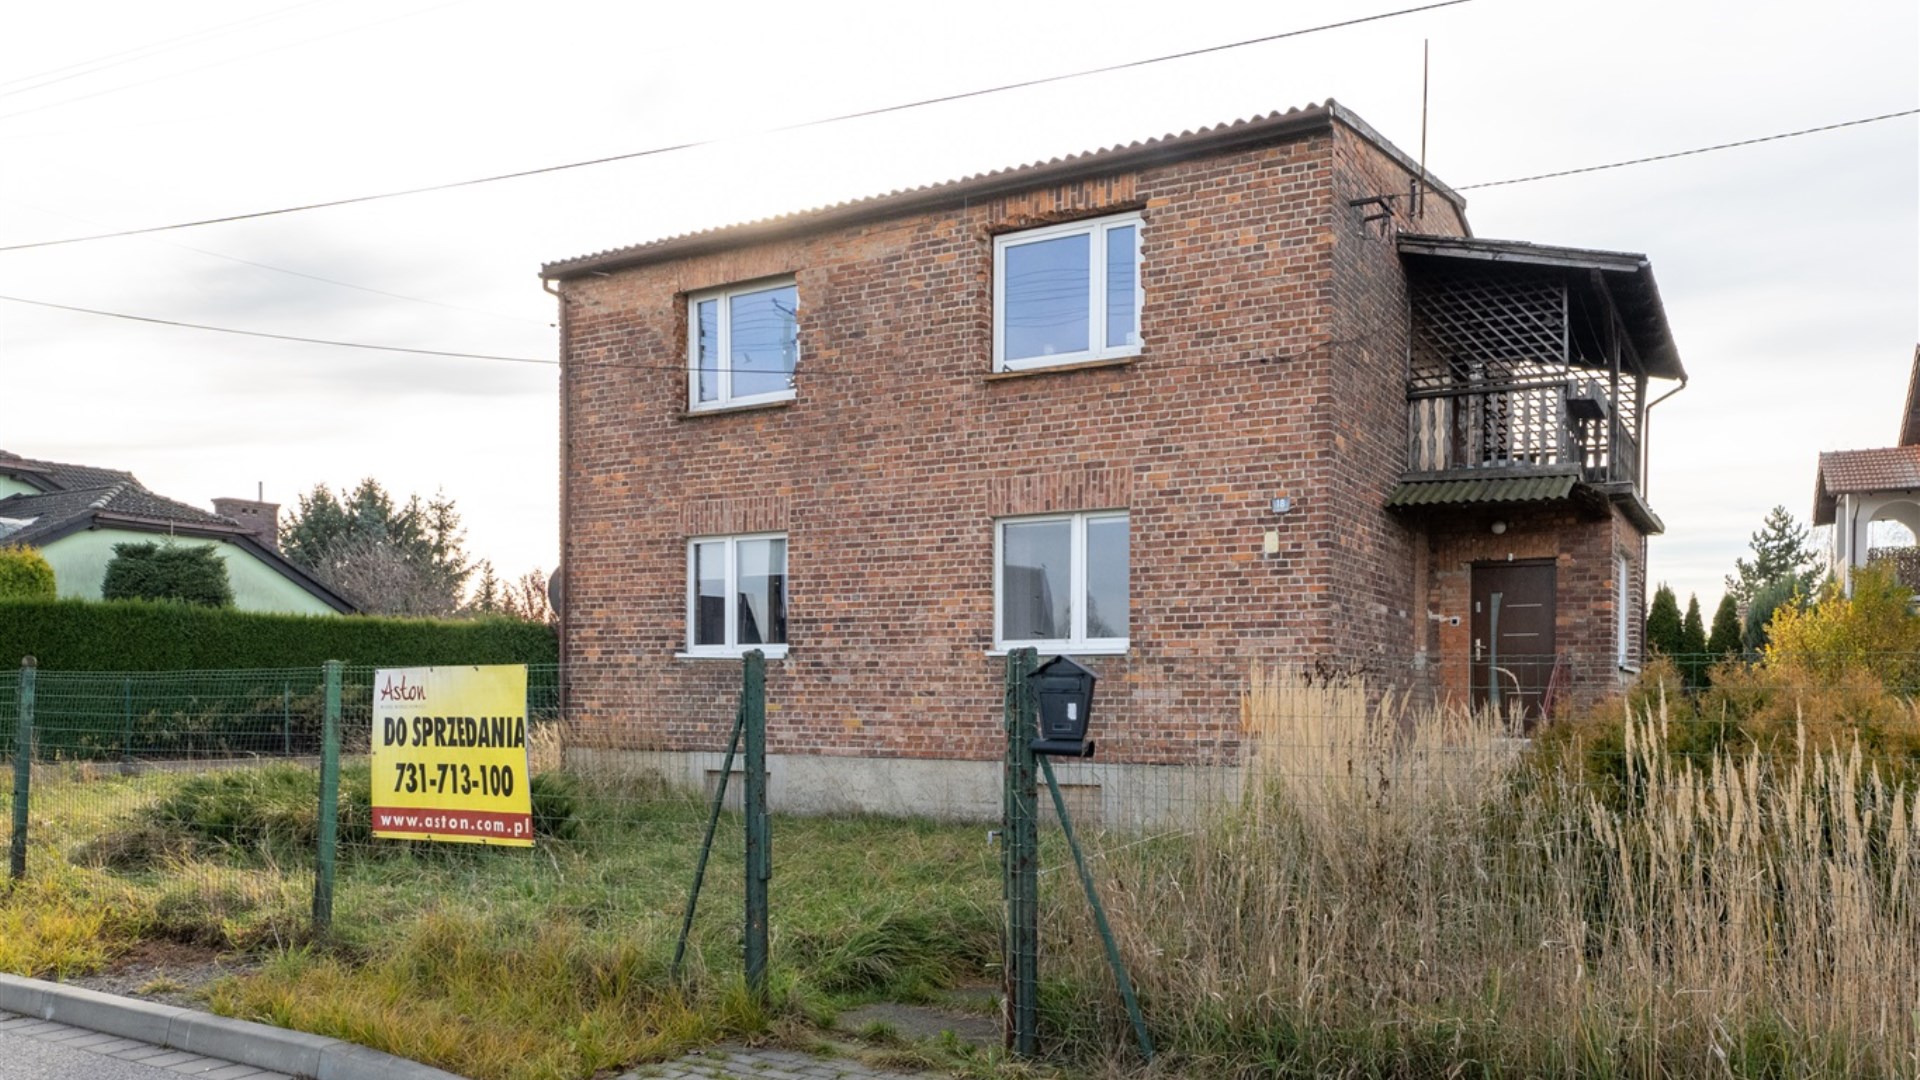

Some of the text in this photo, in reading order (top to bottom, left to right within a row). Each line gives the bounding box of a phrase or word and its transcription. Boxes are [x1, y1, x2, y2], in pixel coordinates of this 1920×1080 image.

[380, 675, 427, 701] Aston
[384, 716, 525, 748] DO SPRZEDANIA
[394, 763, 514, 797] 731-713-100
[380, 814, 530, 837] www.aston.com.pl
